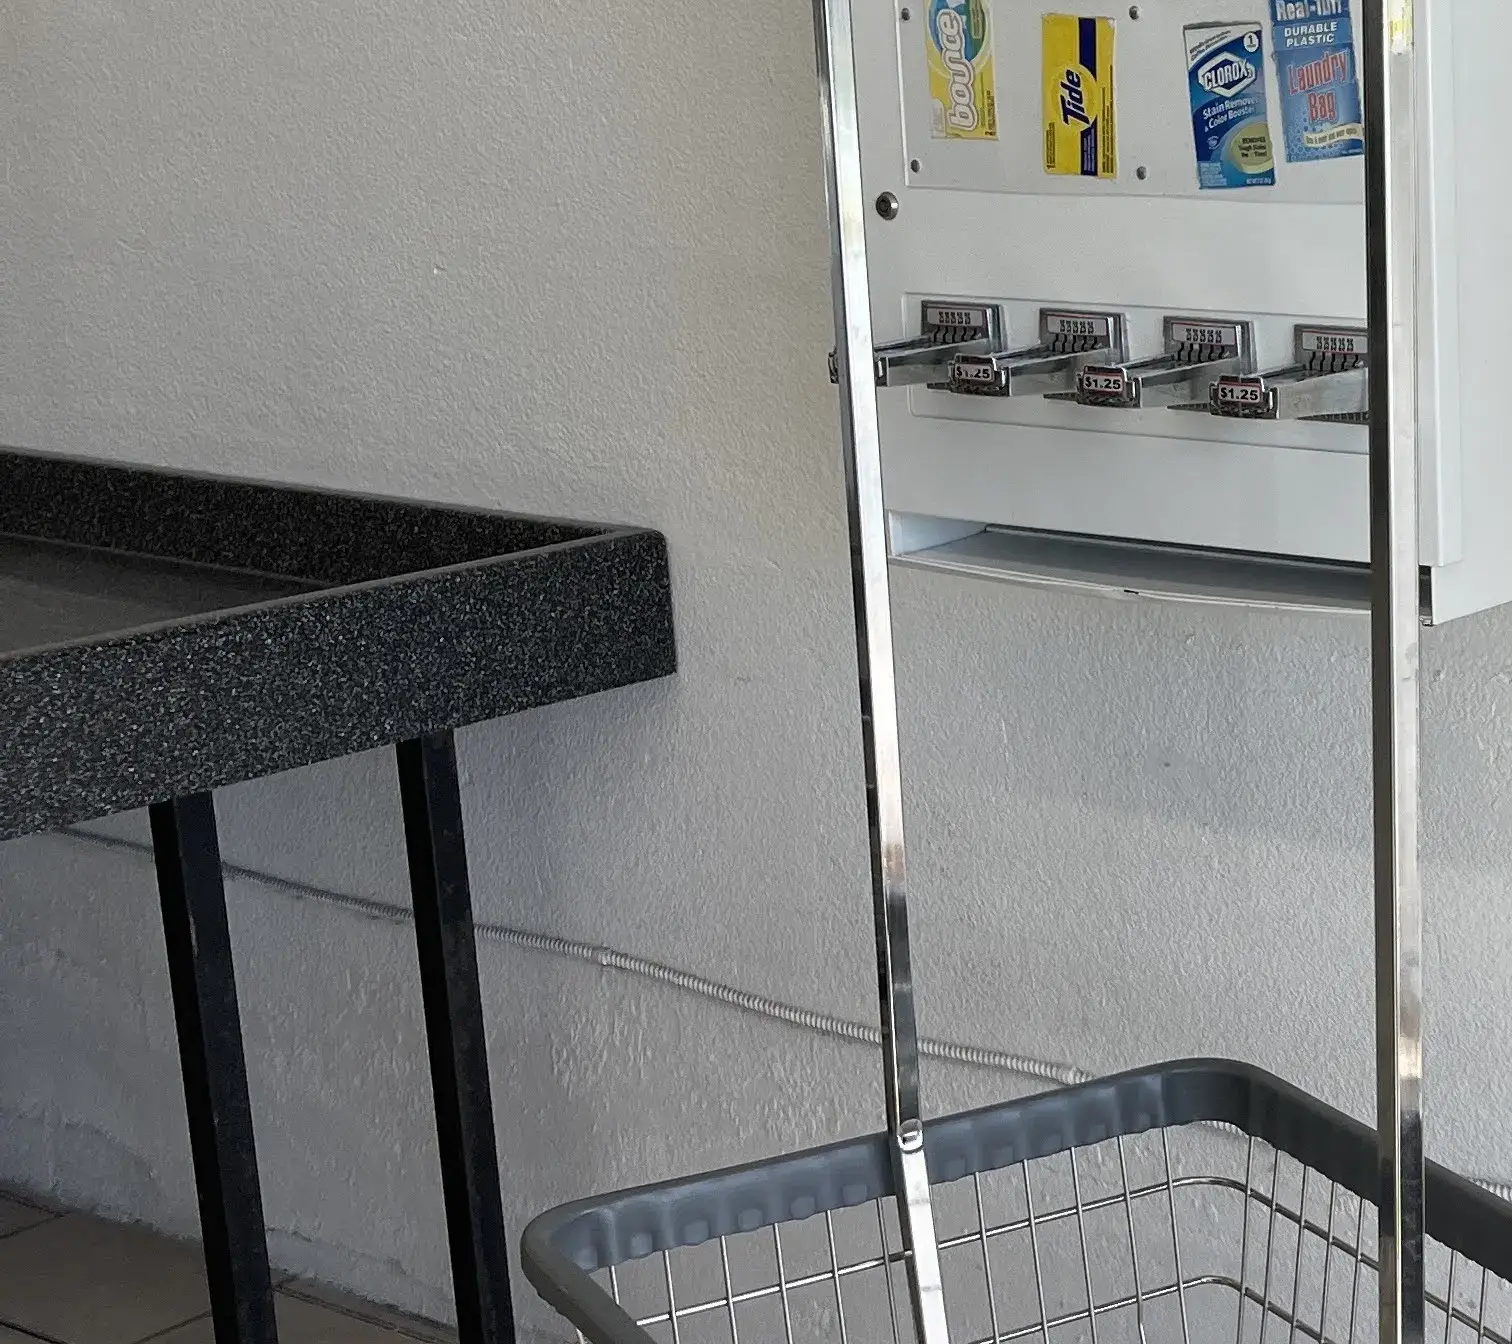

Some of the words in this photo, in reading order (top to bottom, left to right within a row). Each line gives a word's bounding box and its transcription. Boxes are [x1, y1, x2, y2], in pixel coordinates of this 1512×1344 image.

[1284, 21, 1338, 37] DURABLE
[1286, 33, 1335, 48] PLASTIC
[936, 9, 978, 131] bounce
[1287, 50, 1350, 96] Laundry
[1060, 68, 1091, 126] Tide
[1202, 101, 1225, 120] Stain
[1308, 91, 1337, 122] Bag
[1208, 111, 1229, 129] Color
[956, 365, 991, 380] $1.25
[1085, 376, 1122, 391] $1.25
[1220, 387, 1259, 401] $1.25
